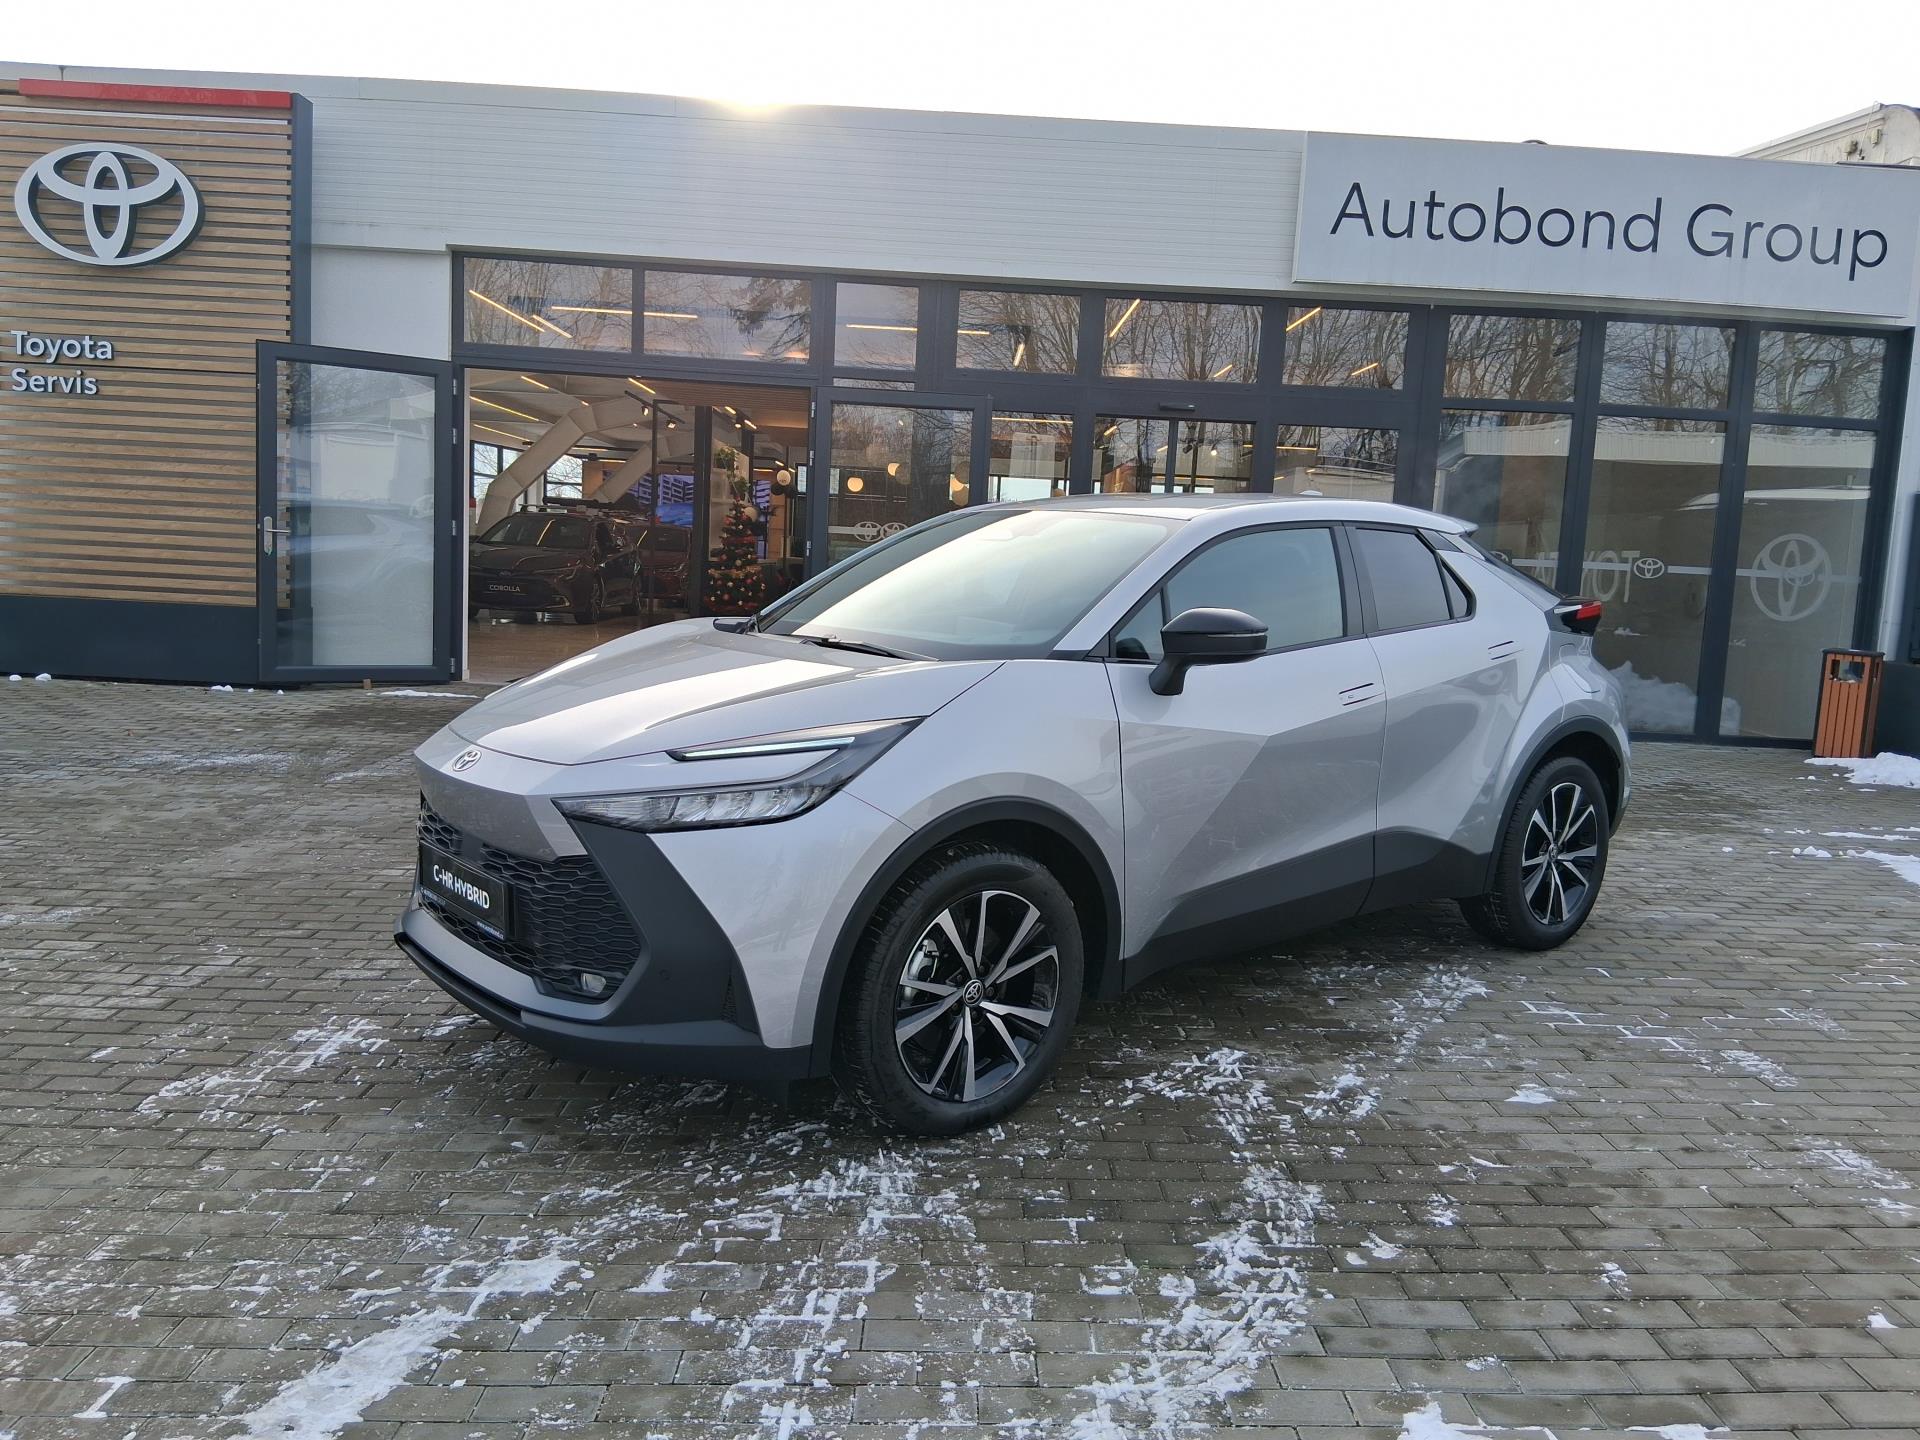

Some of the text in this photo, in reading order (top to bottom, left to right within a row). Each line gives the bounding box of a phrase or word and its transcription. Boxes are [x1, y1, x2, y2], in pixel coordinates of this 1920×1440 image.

[1330, 181, 1889, 281] Autobond Group
[10, 330, 113, 363] Toyota
[11, 367, 98, 395] Servis
[489, 584, 521, 593] COROLLA
[433, 864, 454, 890] C-HR
[454, 876, 490, 909] HYBRID
